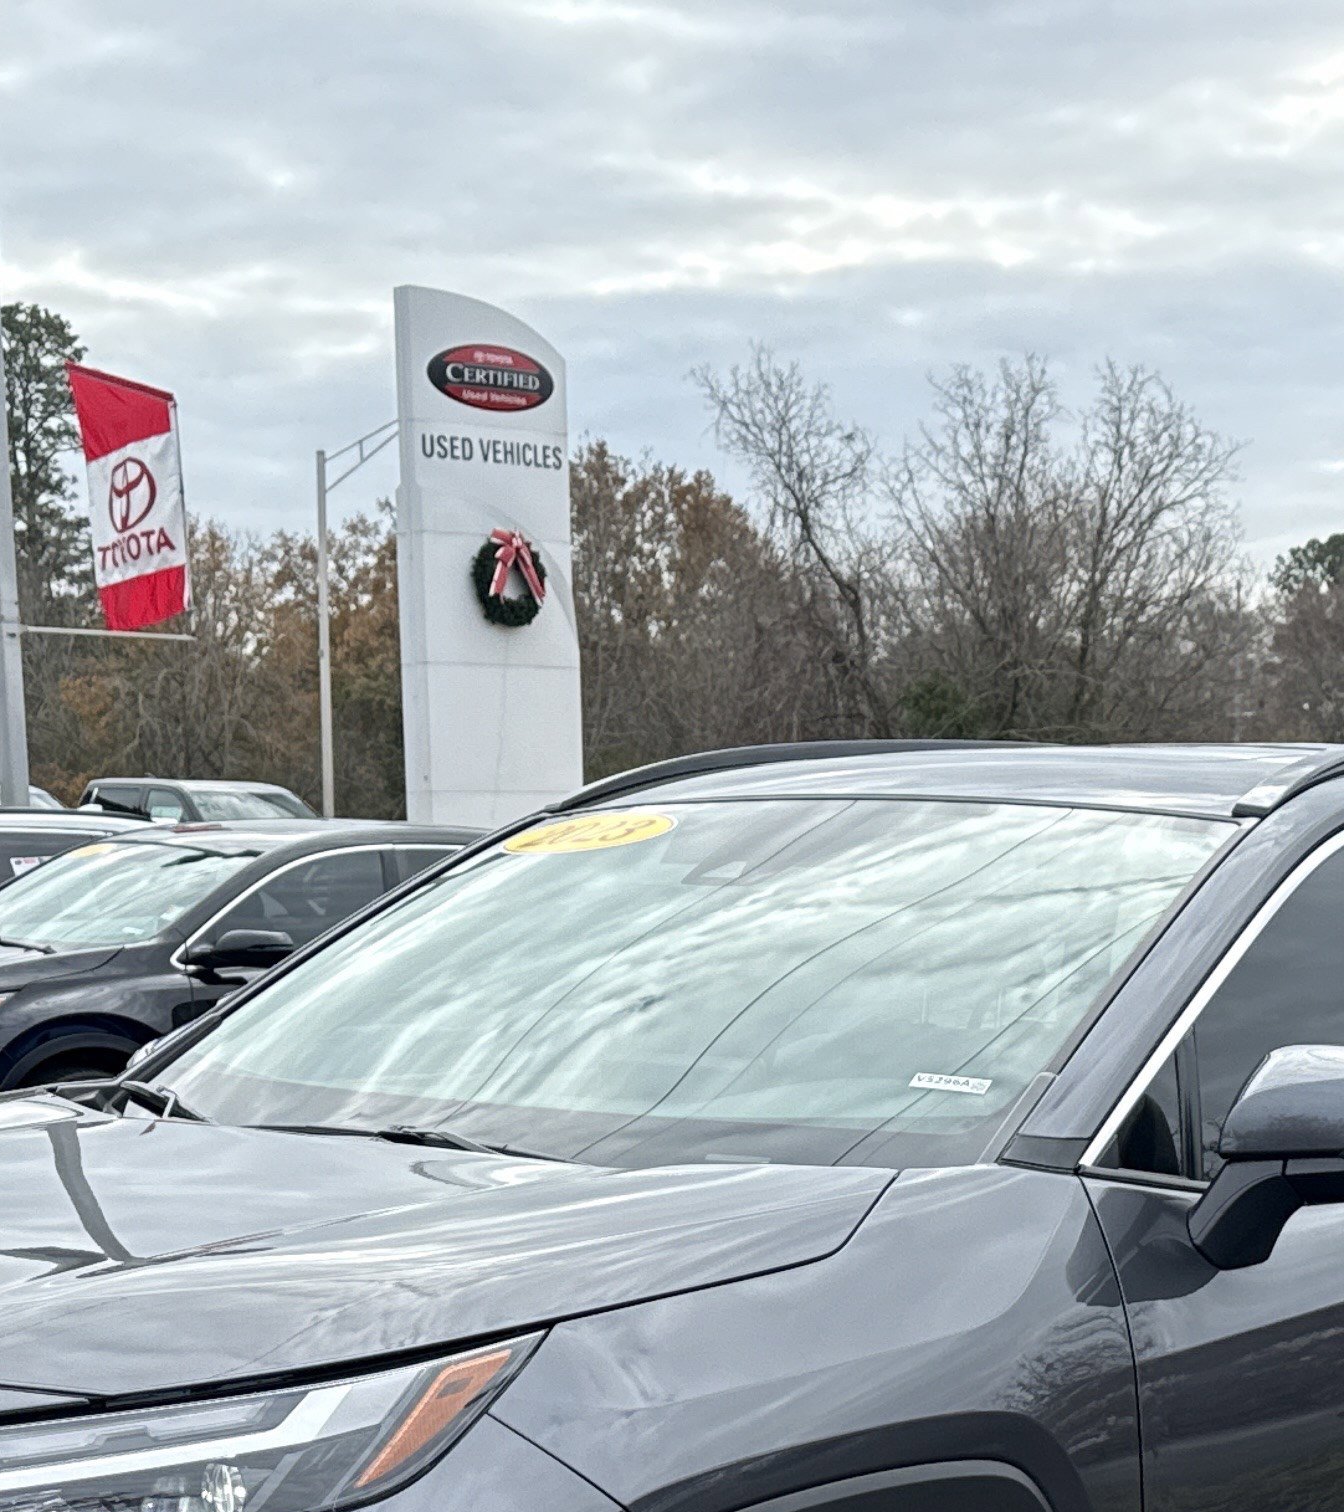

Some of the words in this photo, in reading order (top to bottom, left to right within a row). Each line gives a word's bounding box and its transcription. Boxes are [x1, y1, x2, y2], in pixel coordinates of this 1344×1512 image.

[445, 362, 540, 391] CERTIFIED
[421, 433, 474, 461] USED
[478, 438, 563, 470] VEHICLES
